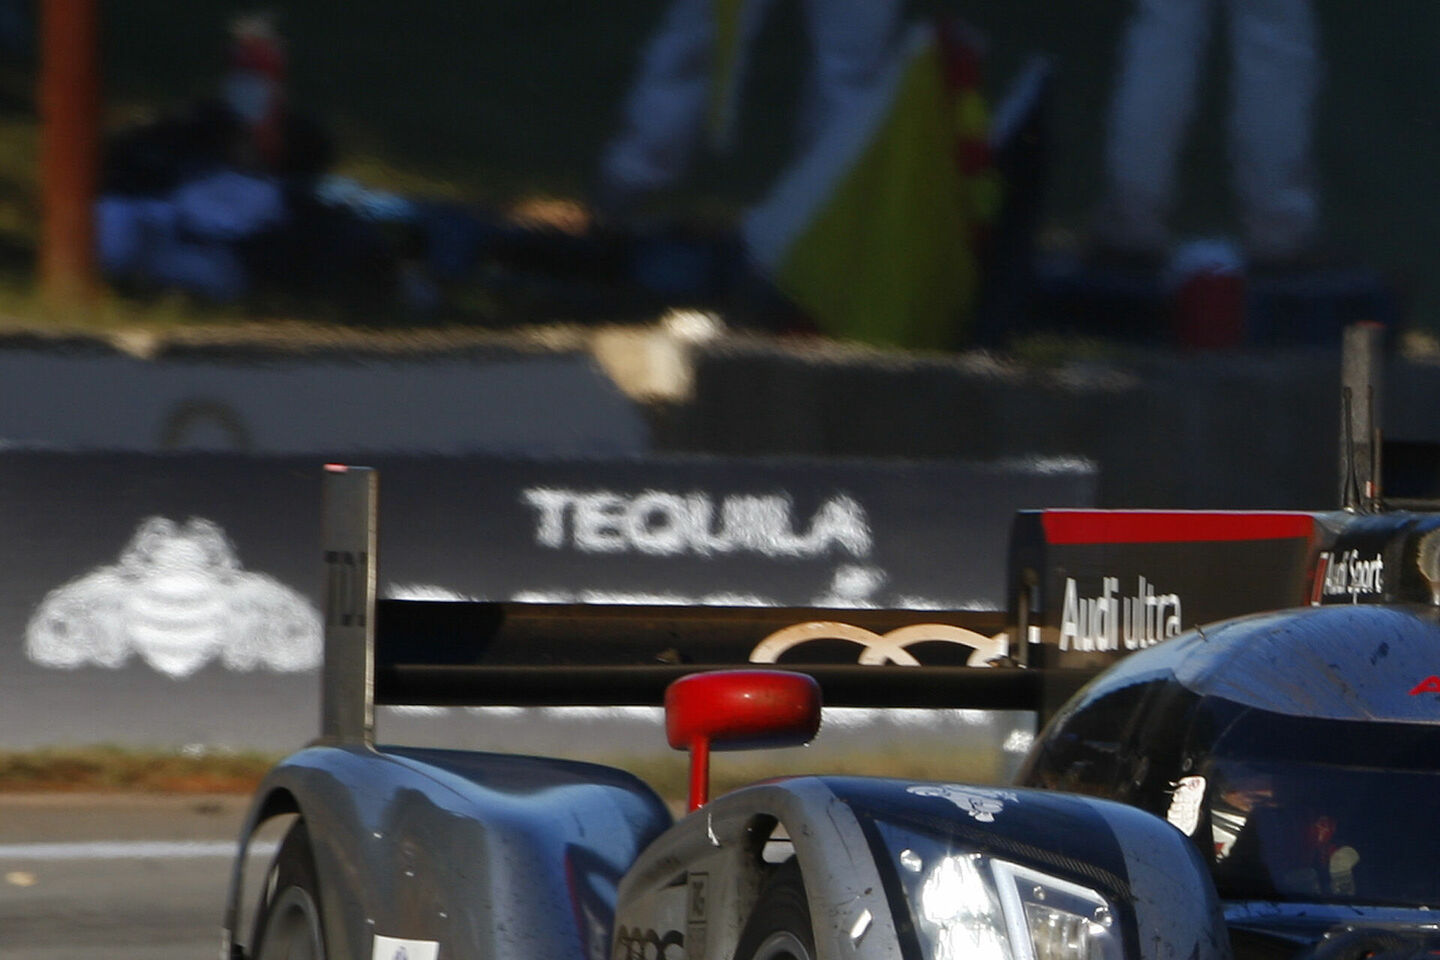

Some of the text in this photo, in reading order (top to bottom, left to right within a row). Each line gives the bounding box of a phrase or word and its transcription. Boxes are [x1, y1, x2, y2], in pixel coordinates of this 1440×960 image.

[523, 487, 873, 558] TEQUILA
[1346, 548, 1385, 605] Sport
[1058, 574, 1182, 651] Audi ultra
